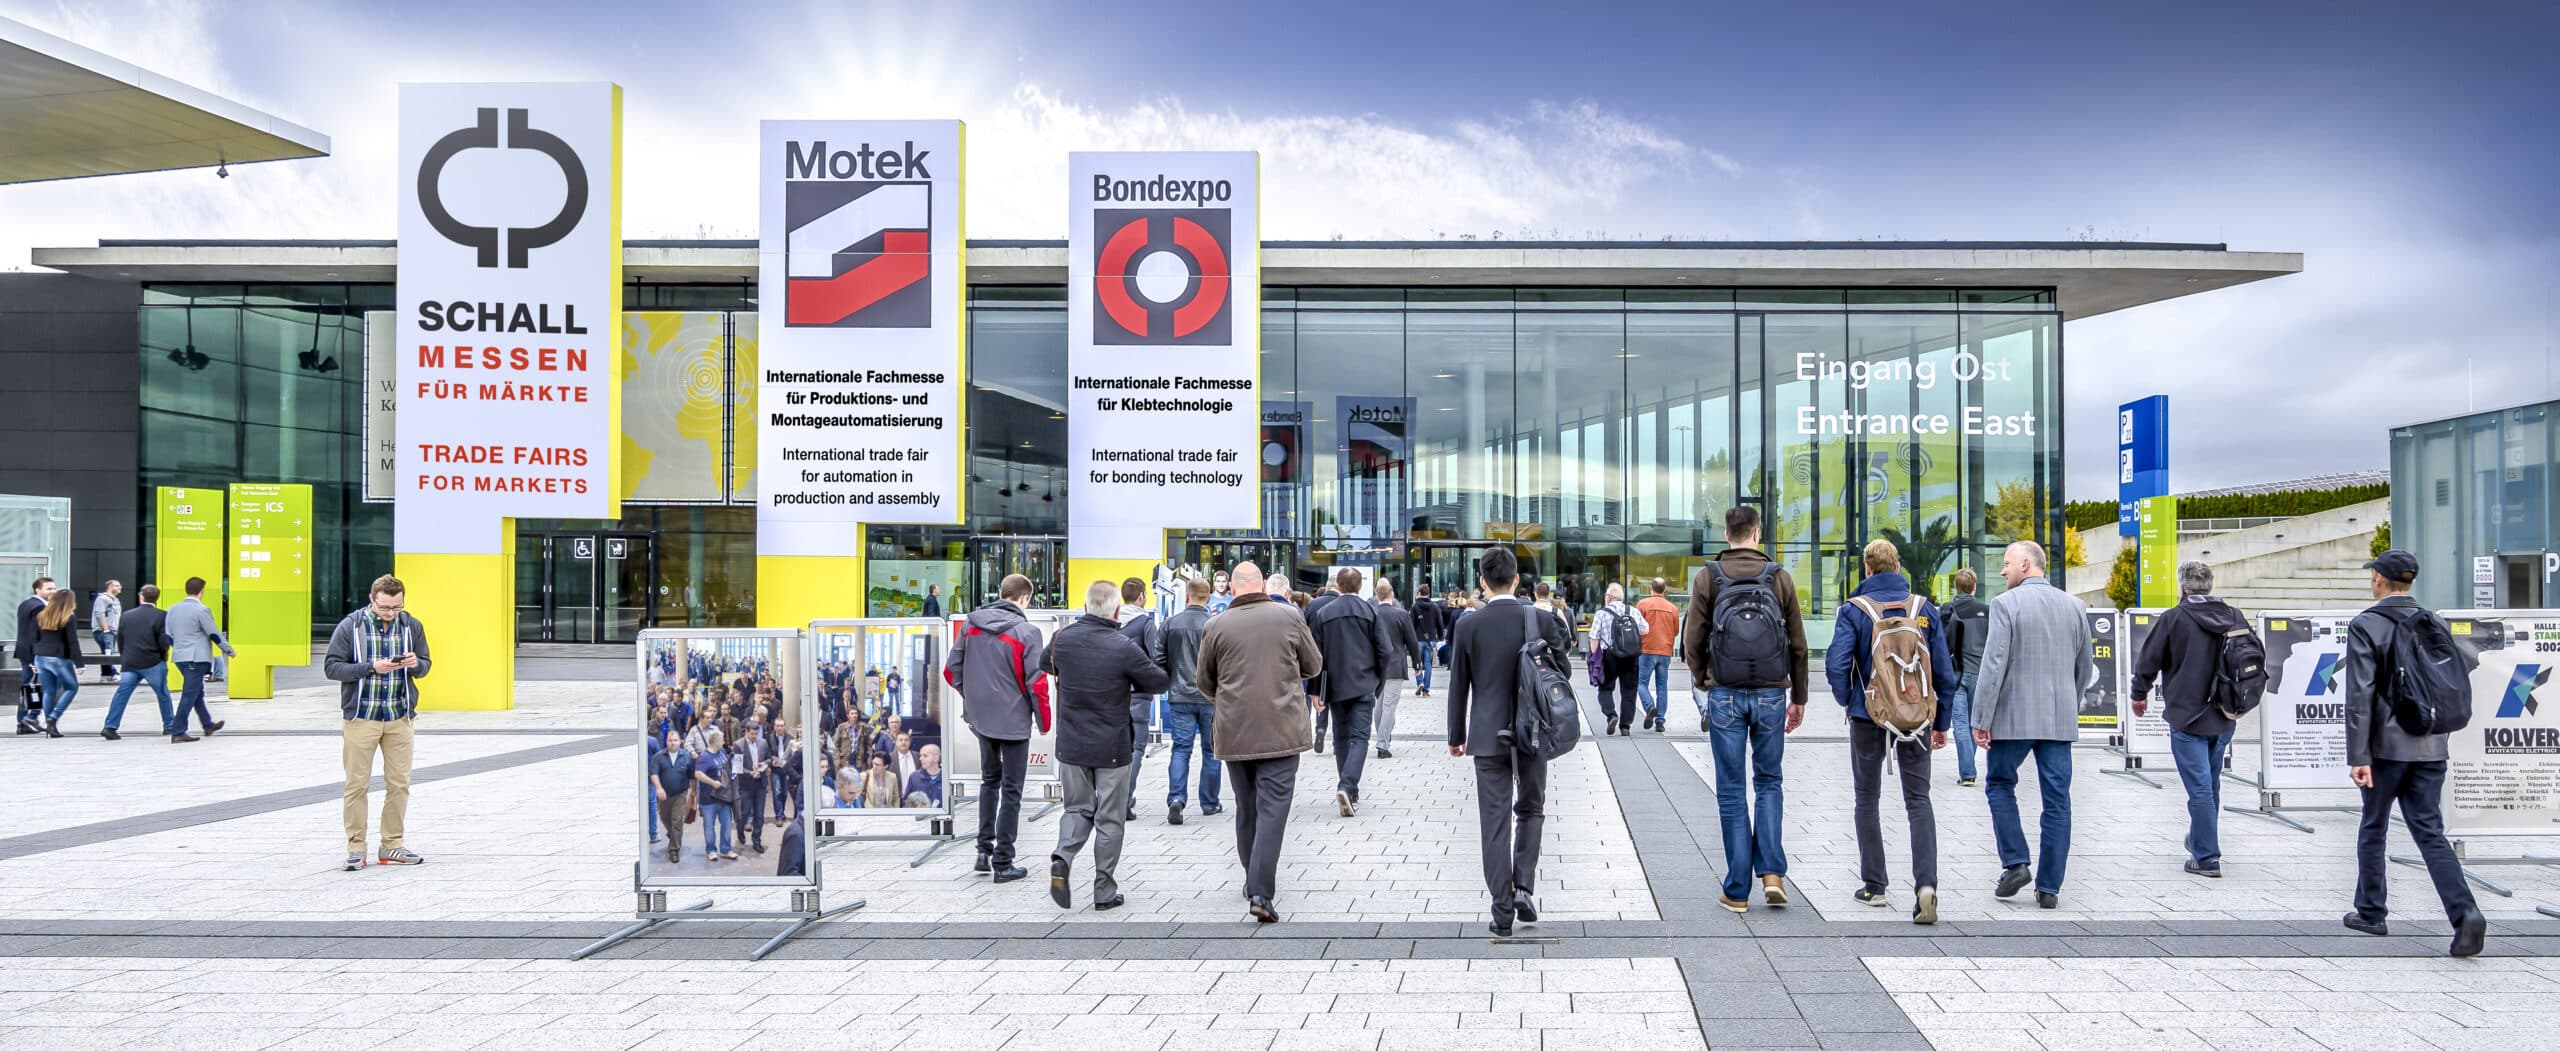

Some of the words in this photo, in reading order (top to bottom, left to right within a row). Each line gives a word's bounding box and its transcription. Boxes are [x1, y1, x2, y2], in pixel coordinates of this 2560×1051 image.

[786, 141, 931, 179] Motek
[1093, 174, 1232, 207] Bondexpo
[418, 301, 588, 334] SCHALL
[419, 346, 587, 371] MESSEN
[767, 370, 863, 384] Internationale
[867, 370, 945, 384] Fachmesse
[1796, 352, 1936, 389] Eingang
[1951, 352, 2012, 382] Ost
[419, 380, 468, 399] FÜR
[480, 381, 588, 402] MÄRKTE
[1074, 376, 1171, 390] Internationale
[1174, 376, 1252, 390] Fachmesse
[786, 391, 807, 405] für
[810, 391, 899, 406] Produktions-
[903, 391, 929, 406] und
[1097, 397, 1118, 411] für
[1121, 397, 1233, 414] Klebtechnologie
[771, 413, 943, 430] Montageautomatisierung
[1796, 406, 1949, 435] Entrance
[1963, 406, 2036, 436] East
[419, 445, 503, 463] TRADE
[514, 447, 587, 467] FAIRS
[783, 448, 865, 462] International
[868, 448, 903, 462] trade
[907, 448, 928, 462] fair
[1092, 448, 1174, 462] International
[1177, 448, 1213, 462] trade
[1216, 448, 1239, 462] fair
[801, 469, 821, 483] for
[824, 469, 898, 483] automation
[902, 469, 912, 483] in
[1090, 469, 1109, 484] for
[1112, 469, 1166, 487] bonding
[1169, 470, 1243, 488] technology
[419, 475, 465, 491] FOR
[475, 477, 588, 495] MARKETS
[265, 502, 284, 513] ICS
[774, 491, 845, 508] production
[849, 491, 874, 505] and
[877, 491, 941, 509] assembly
[2134, 501, 2140, 521] B
[256, 518, 261, 529] 1
[2336, 635, 2346, 644] 30
[2093, 646, 2111, 658] ER
[2296, 703, 2346, 719] KOLVE
[2484, 728, 2560, 747] KOLVER
